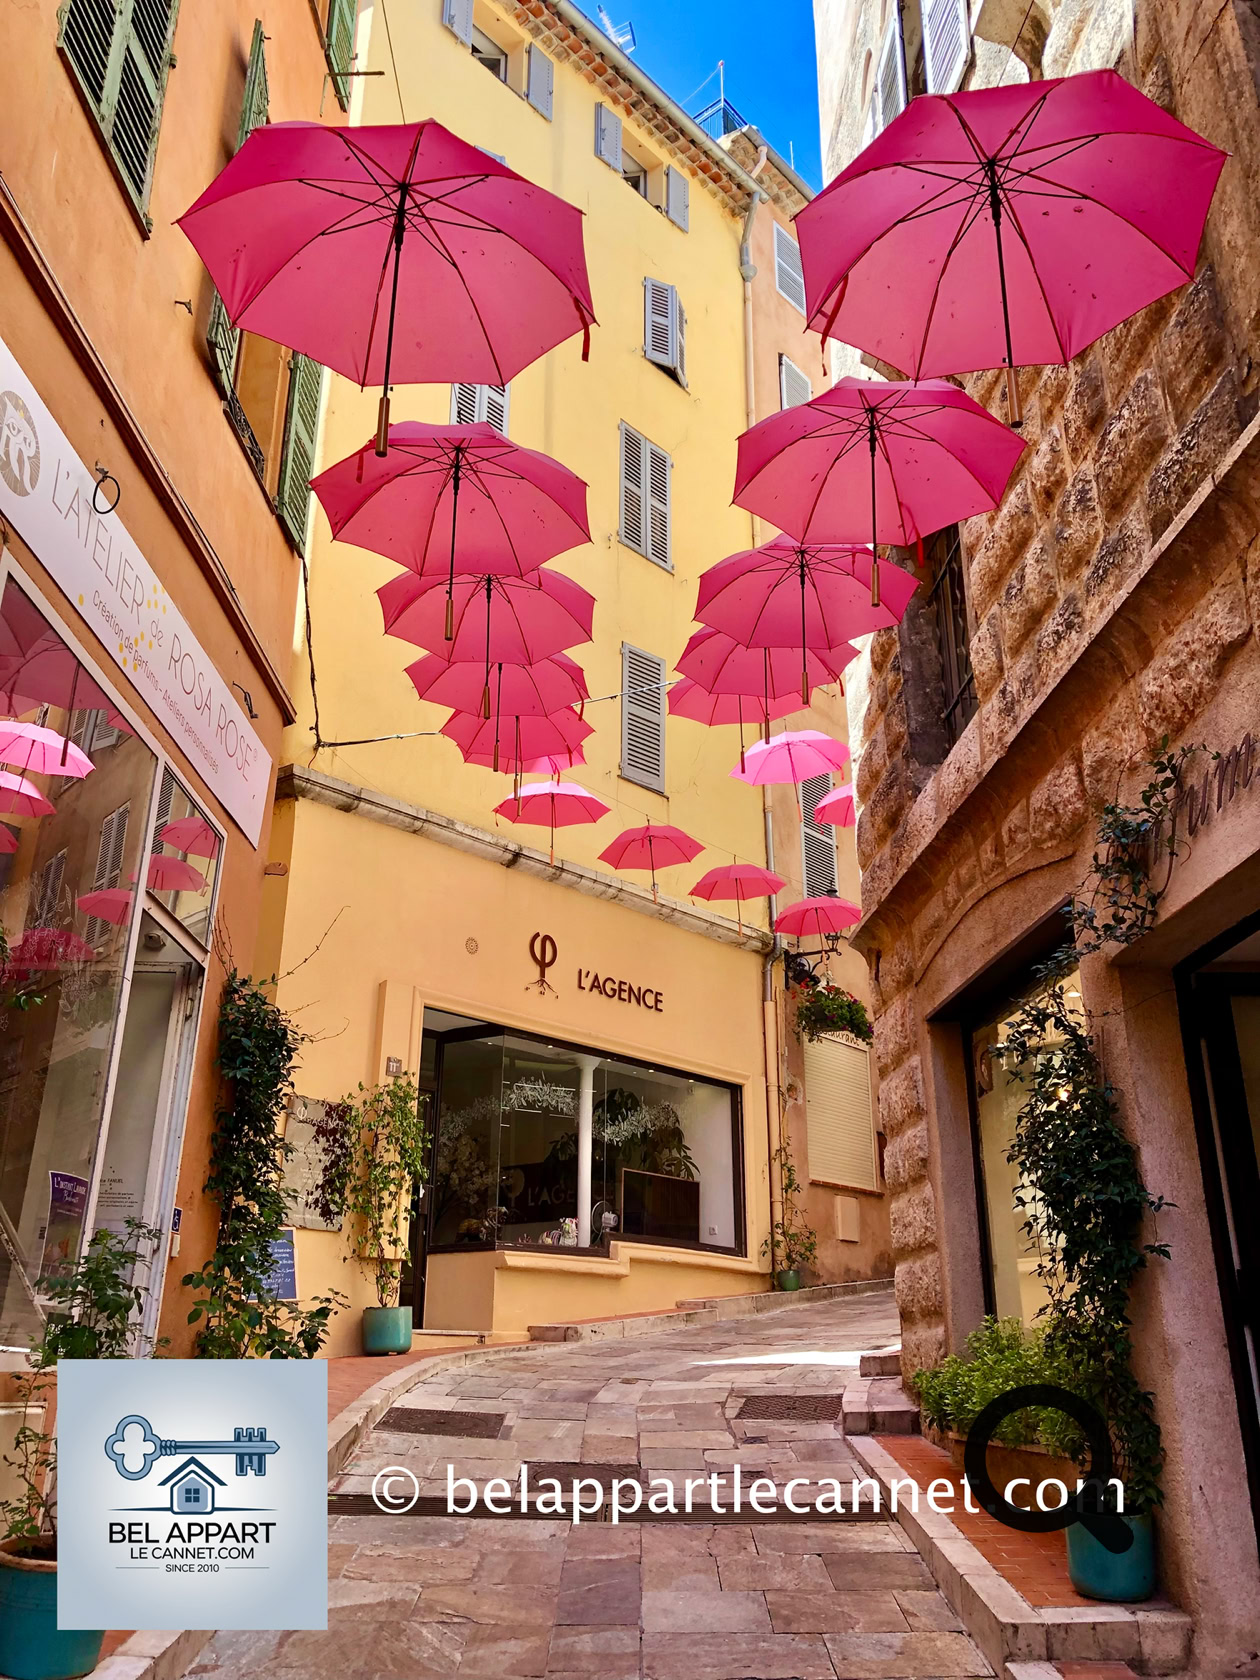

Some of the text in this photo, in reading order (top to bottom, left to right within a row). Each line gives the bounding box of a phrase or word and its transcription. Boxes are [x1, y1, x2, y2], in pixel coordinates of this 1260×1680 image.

[52, 458, 145, 625] L'ATELIER
[150, 617, 164, 649] de
[168, 633, 213, 728] ROSA
[92, 589, 124, 642] Création
[124, 635, 134, 654] de
[132, 649, 159, 691] parfums
[162, 689, 186, 728] Ateliers
[576, 967, 664, 1013] L'AGENCE
